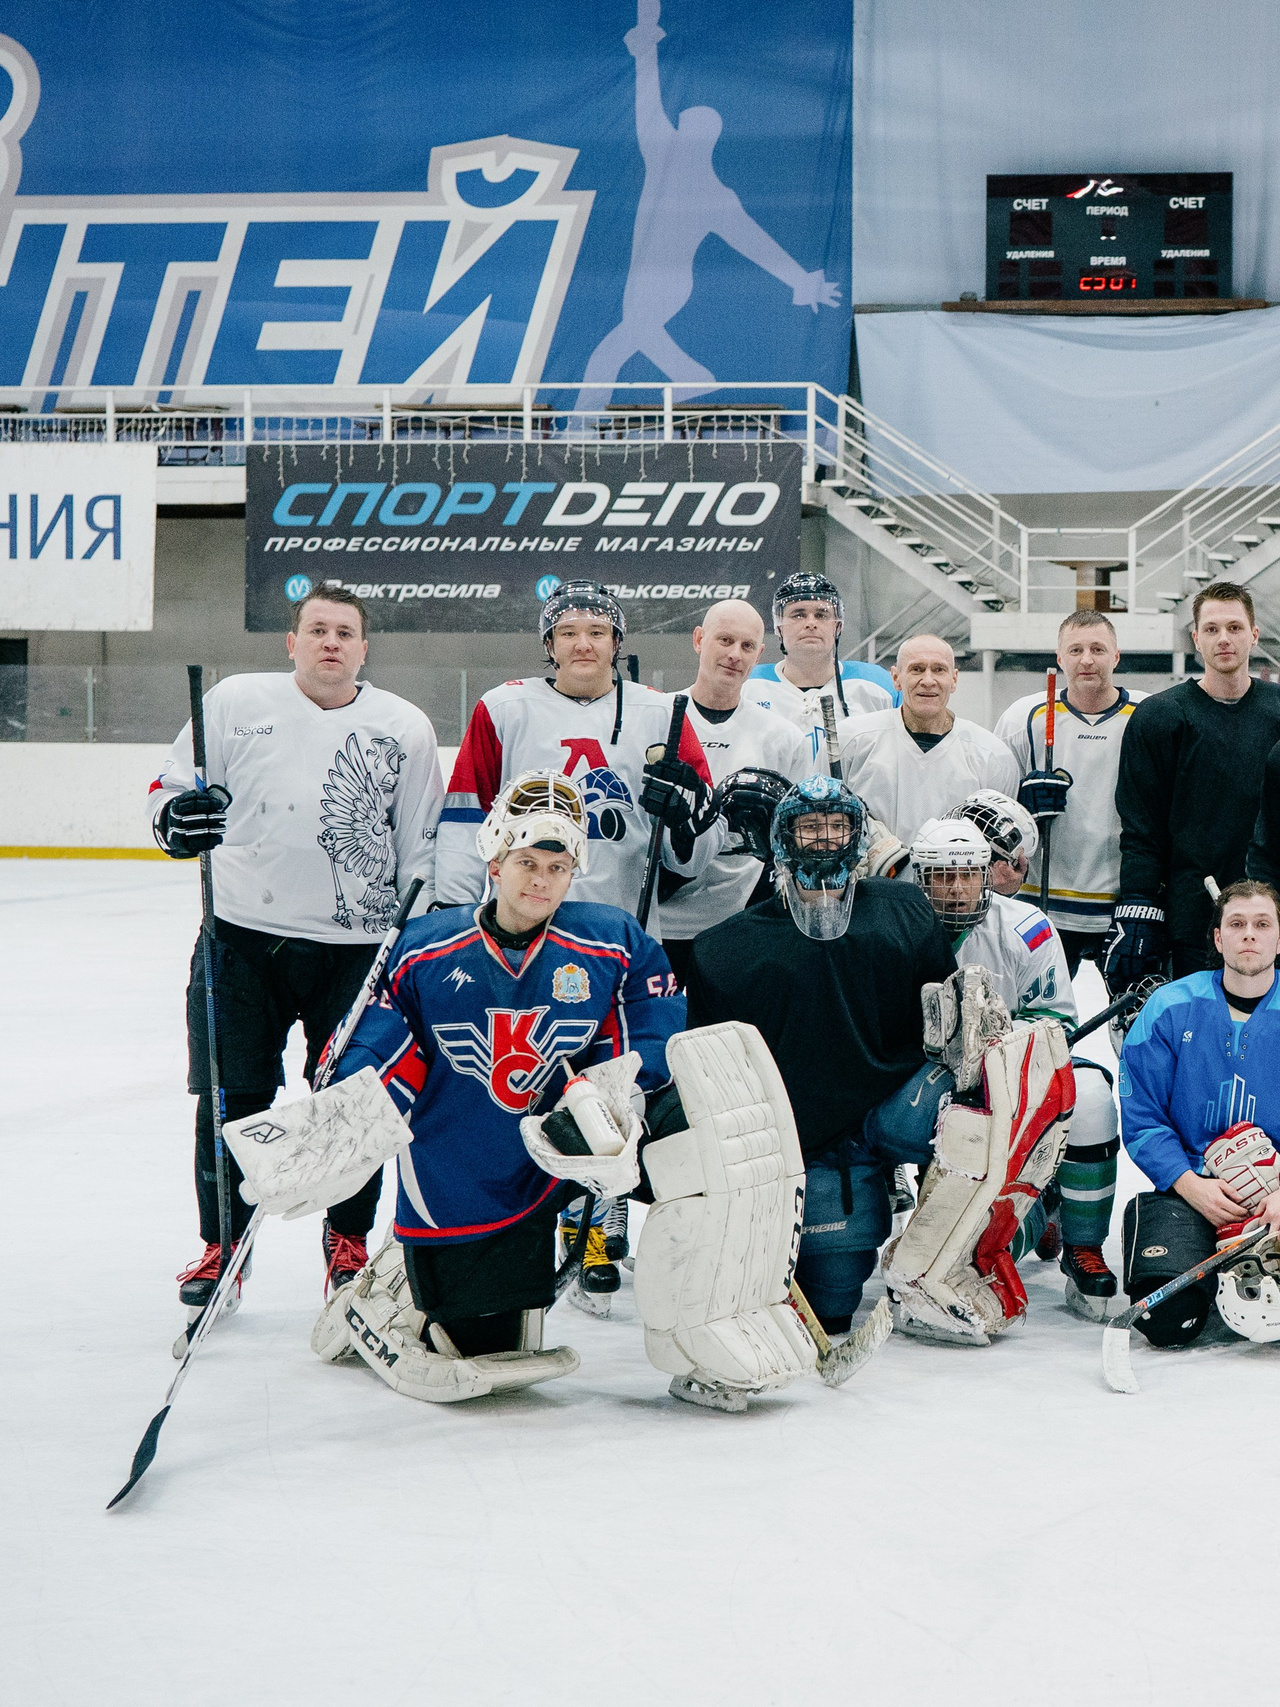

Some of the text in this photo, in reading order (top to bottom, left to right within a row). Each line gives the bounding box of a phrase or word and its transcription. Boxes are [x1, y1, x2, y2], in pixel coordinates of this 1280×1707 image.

[1013, 198, 1049, 211] СЧЕТ
[1169, 197, 1205, 209] СЧЕТ
[1086, 206, 1129, 217] ПЕРИОД
[1006, 250, 1055, 260] УДАЛЕНИЯ
[1161, 249, 1210, 259] УДАЛЕНИЯ
[1090, 255, 1126, 267] ВРЕМЯ
[264, 537, 764, 552] ПРОФЕССИОНАЛЬНЫЕ МАГАЗИНЫ
[606, 584, 751, 599] рьковская
[1077, 733, 1108, 742] BAUER
[1114, 904, 1165, 922] WARRIO
[1213, 1130, 1268, 1168] EASTO
[801, 1220, 848, 1235] PREME
[345, 1305, 400, 1368] CCM
